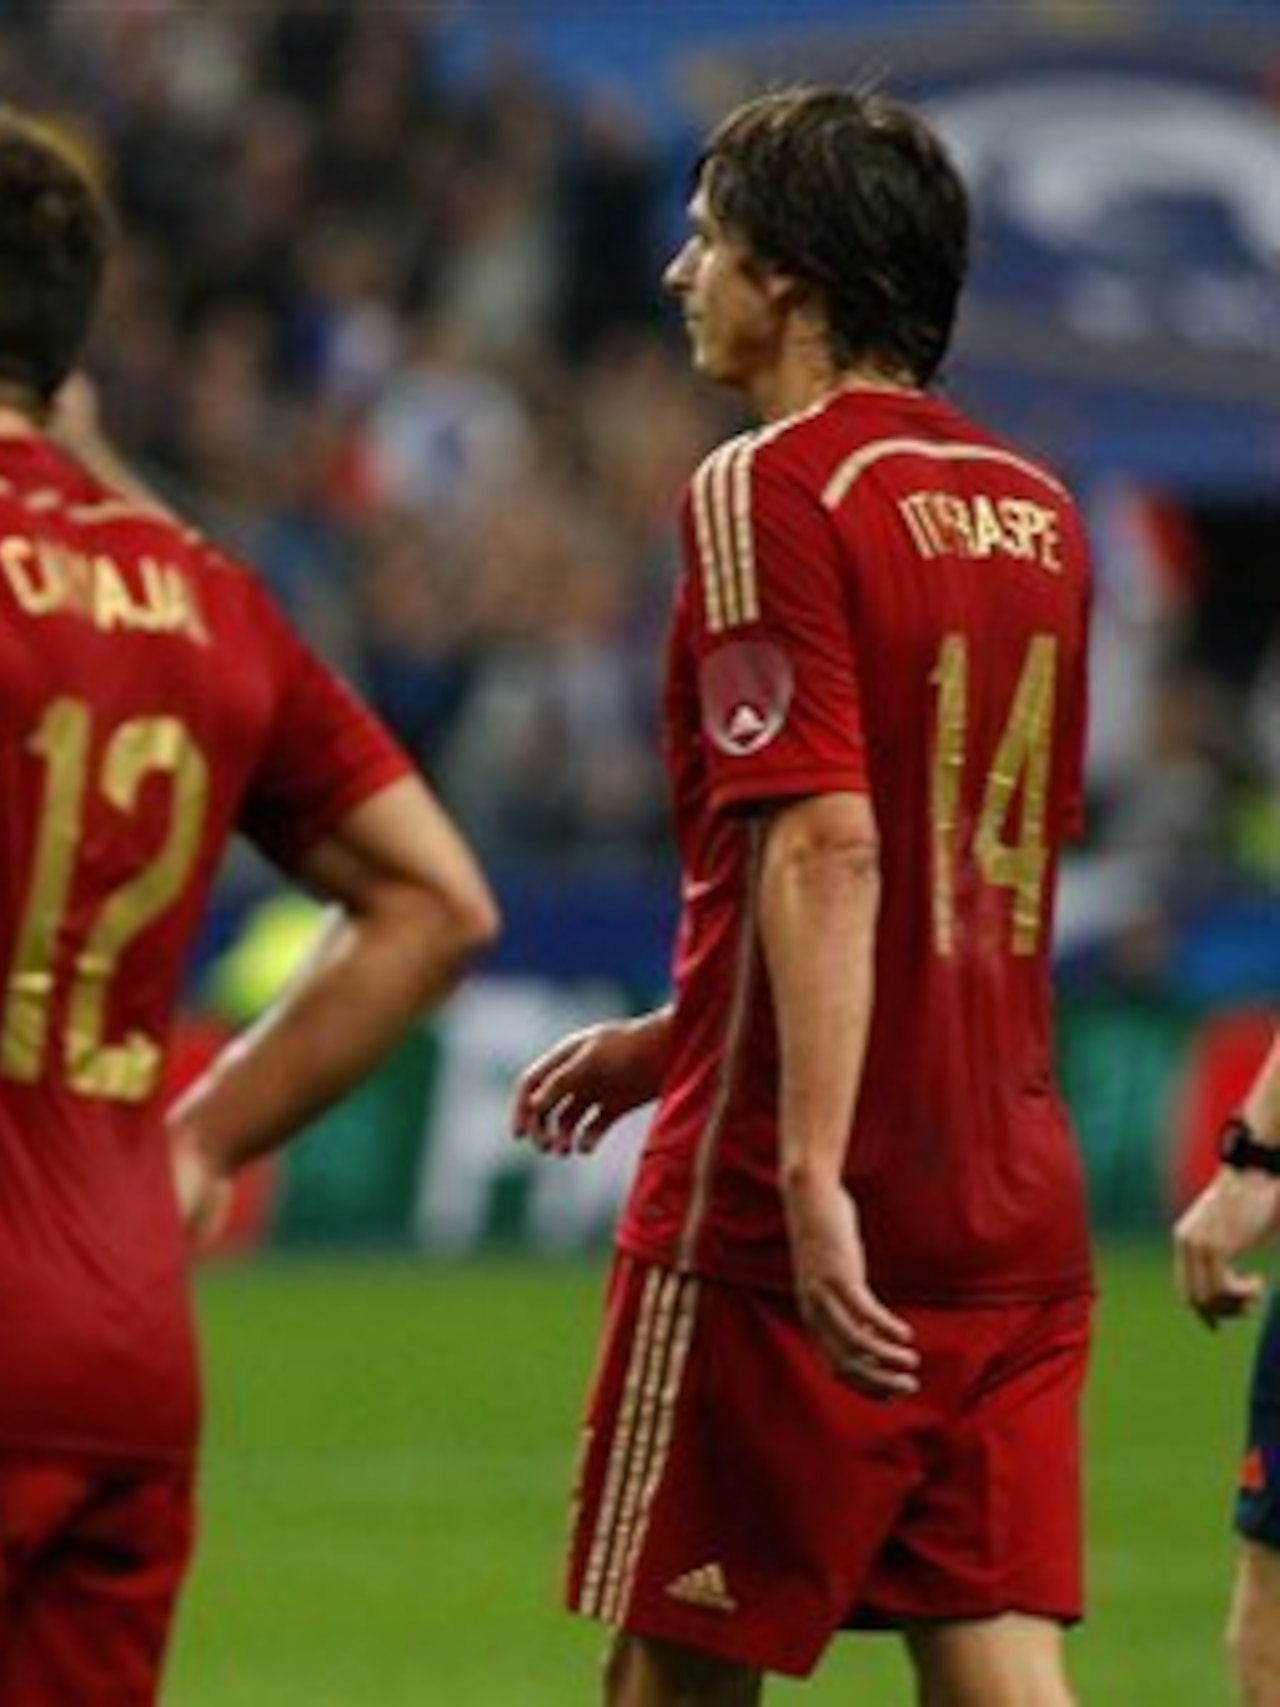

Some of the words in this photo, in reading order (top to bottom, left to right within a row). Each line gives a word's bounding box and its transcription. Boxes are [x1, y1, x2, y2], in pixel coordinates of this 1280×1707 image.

[897, 490, 1063, 573] ITRASPE
[0, 697, 208, 1102] 12
[928, 635, 1057, 956] 14
